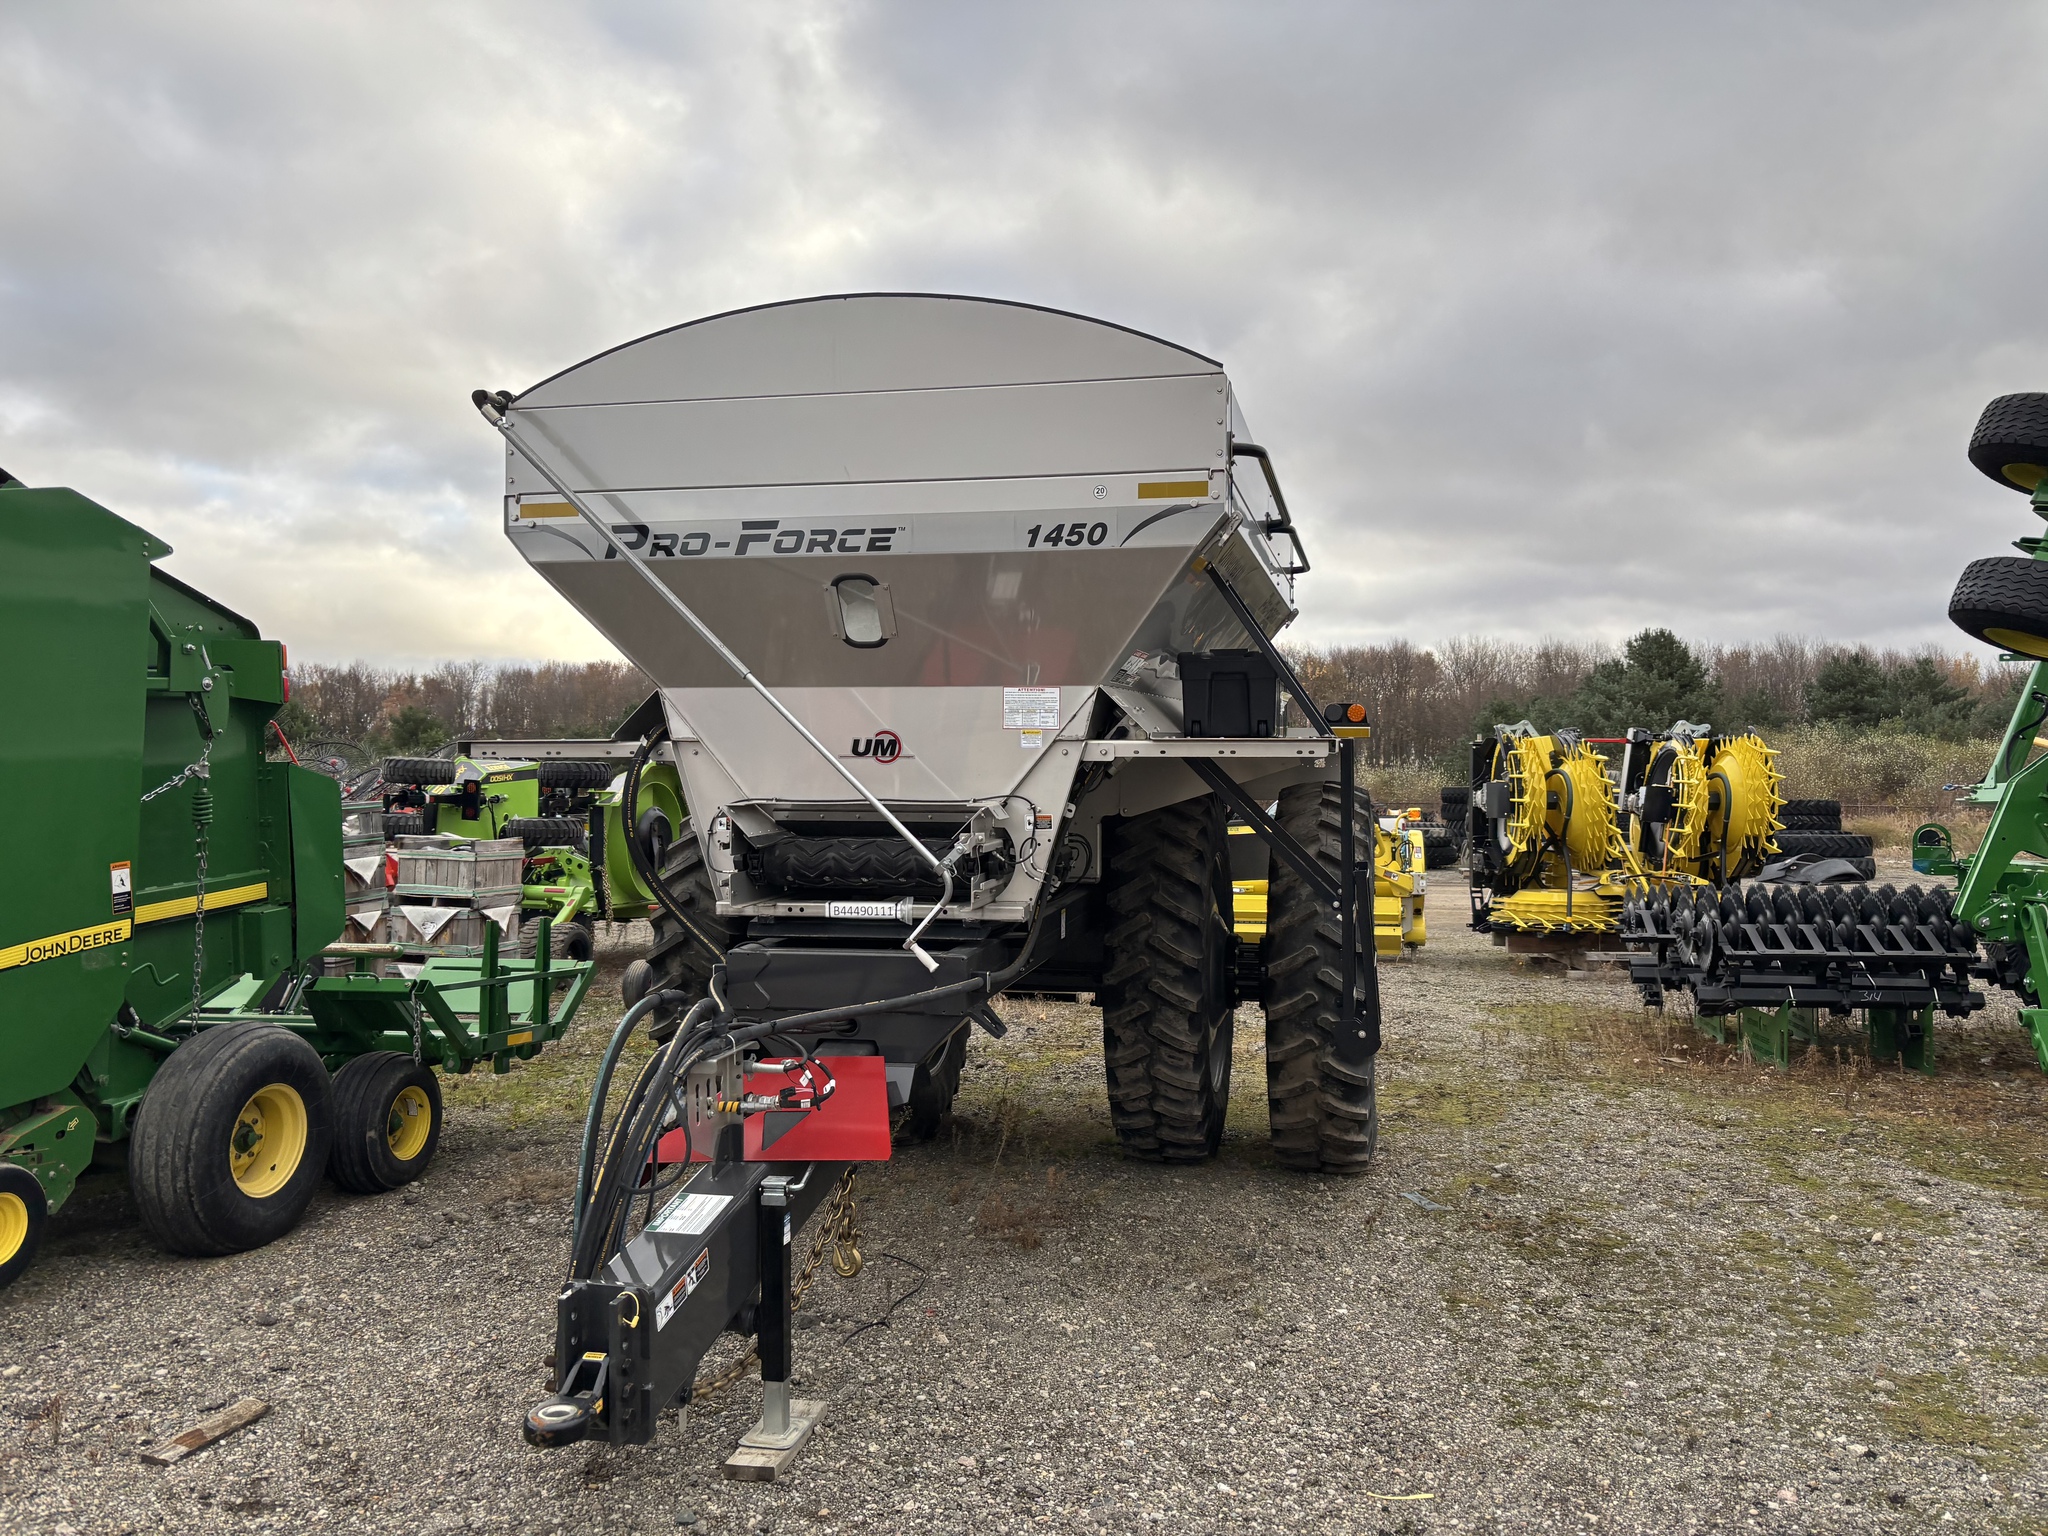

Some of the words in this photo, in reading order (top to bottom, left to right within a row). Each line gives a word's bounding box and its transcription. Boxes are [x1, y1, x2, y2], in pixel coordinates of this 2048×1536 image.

[1095, 487, 1105, 495] 20
[1026, 522, 1108, 548] 1450
[852, 738, 898, 757] UM
[833, 905, 894, 916] B44490111
[19, 939, 67, 965] JOHN
[69, 928, 123, 952] DEERE
[1858, 990, 1882, 1002] 314
